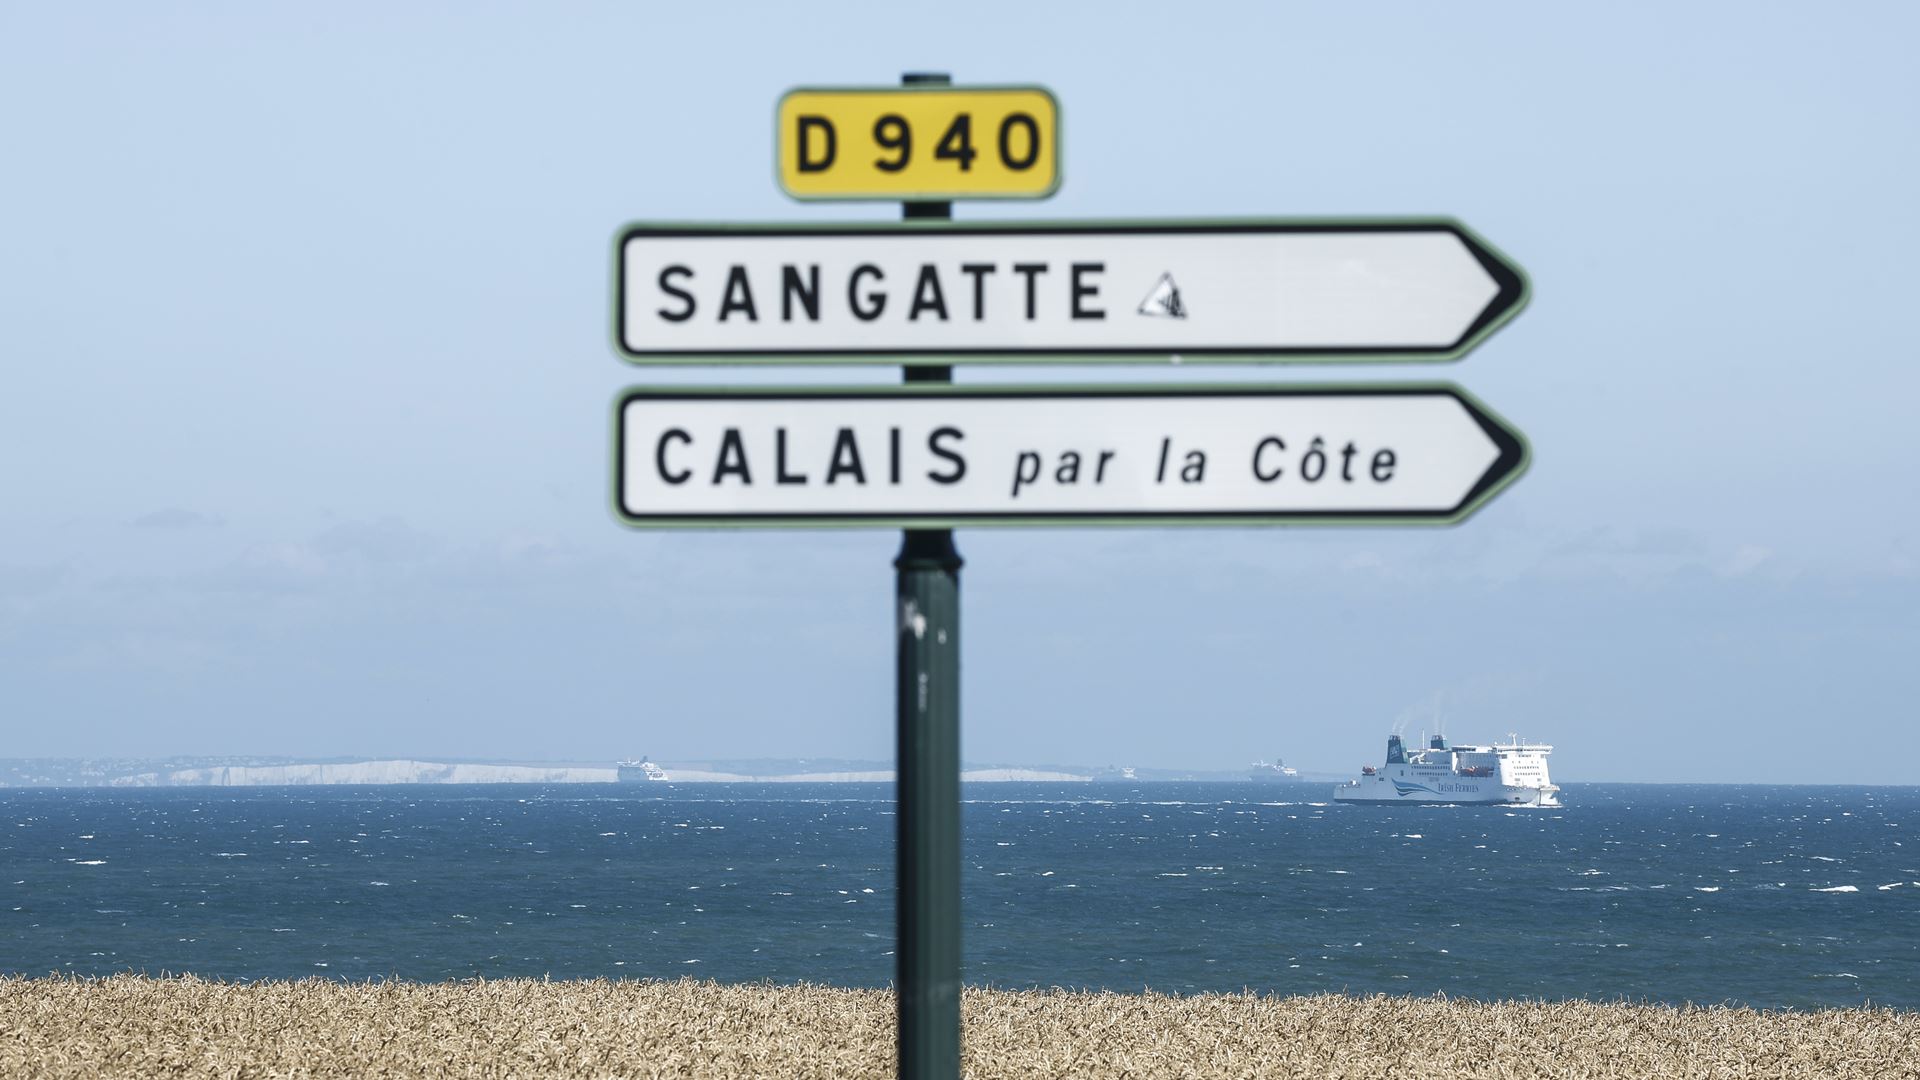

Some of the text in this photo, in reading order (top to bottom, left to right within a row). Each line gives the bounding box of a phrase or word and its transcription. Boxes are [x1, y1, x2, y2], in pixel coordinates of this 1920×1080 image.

[796, 111, 1041, 174] D 940
[657, 262, 1107, 324] SANGATTE
[655, 426, 1398, 498] CALAIS par la Côte
